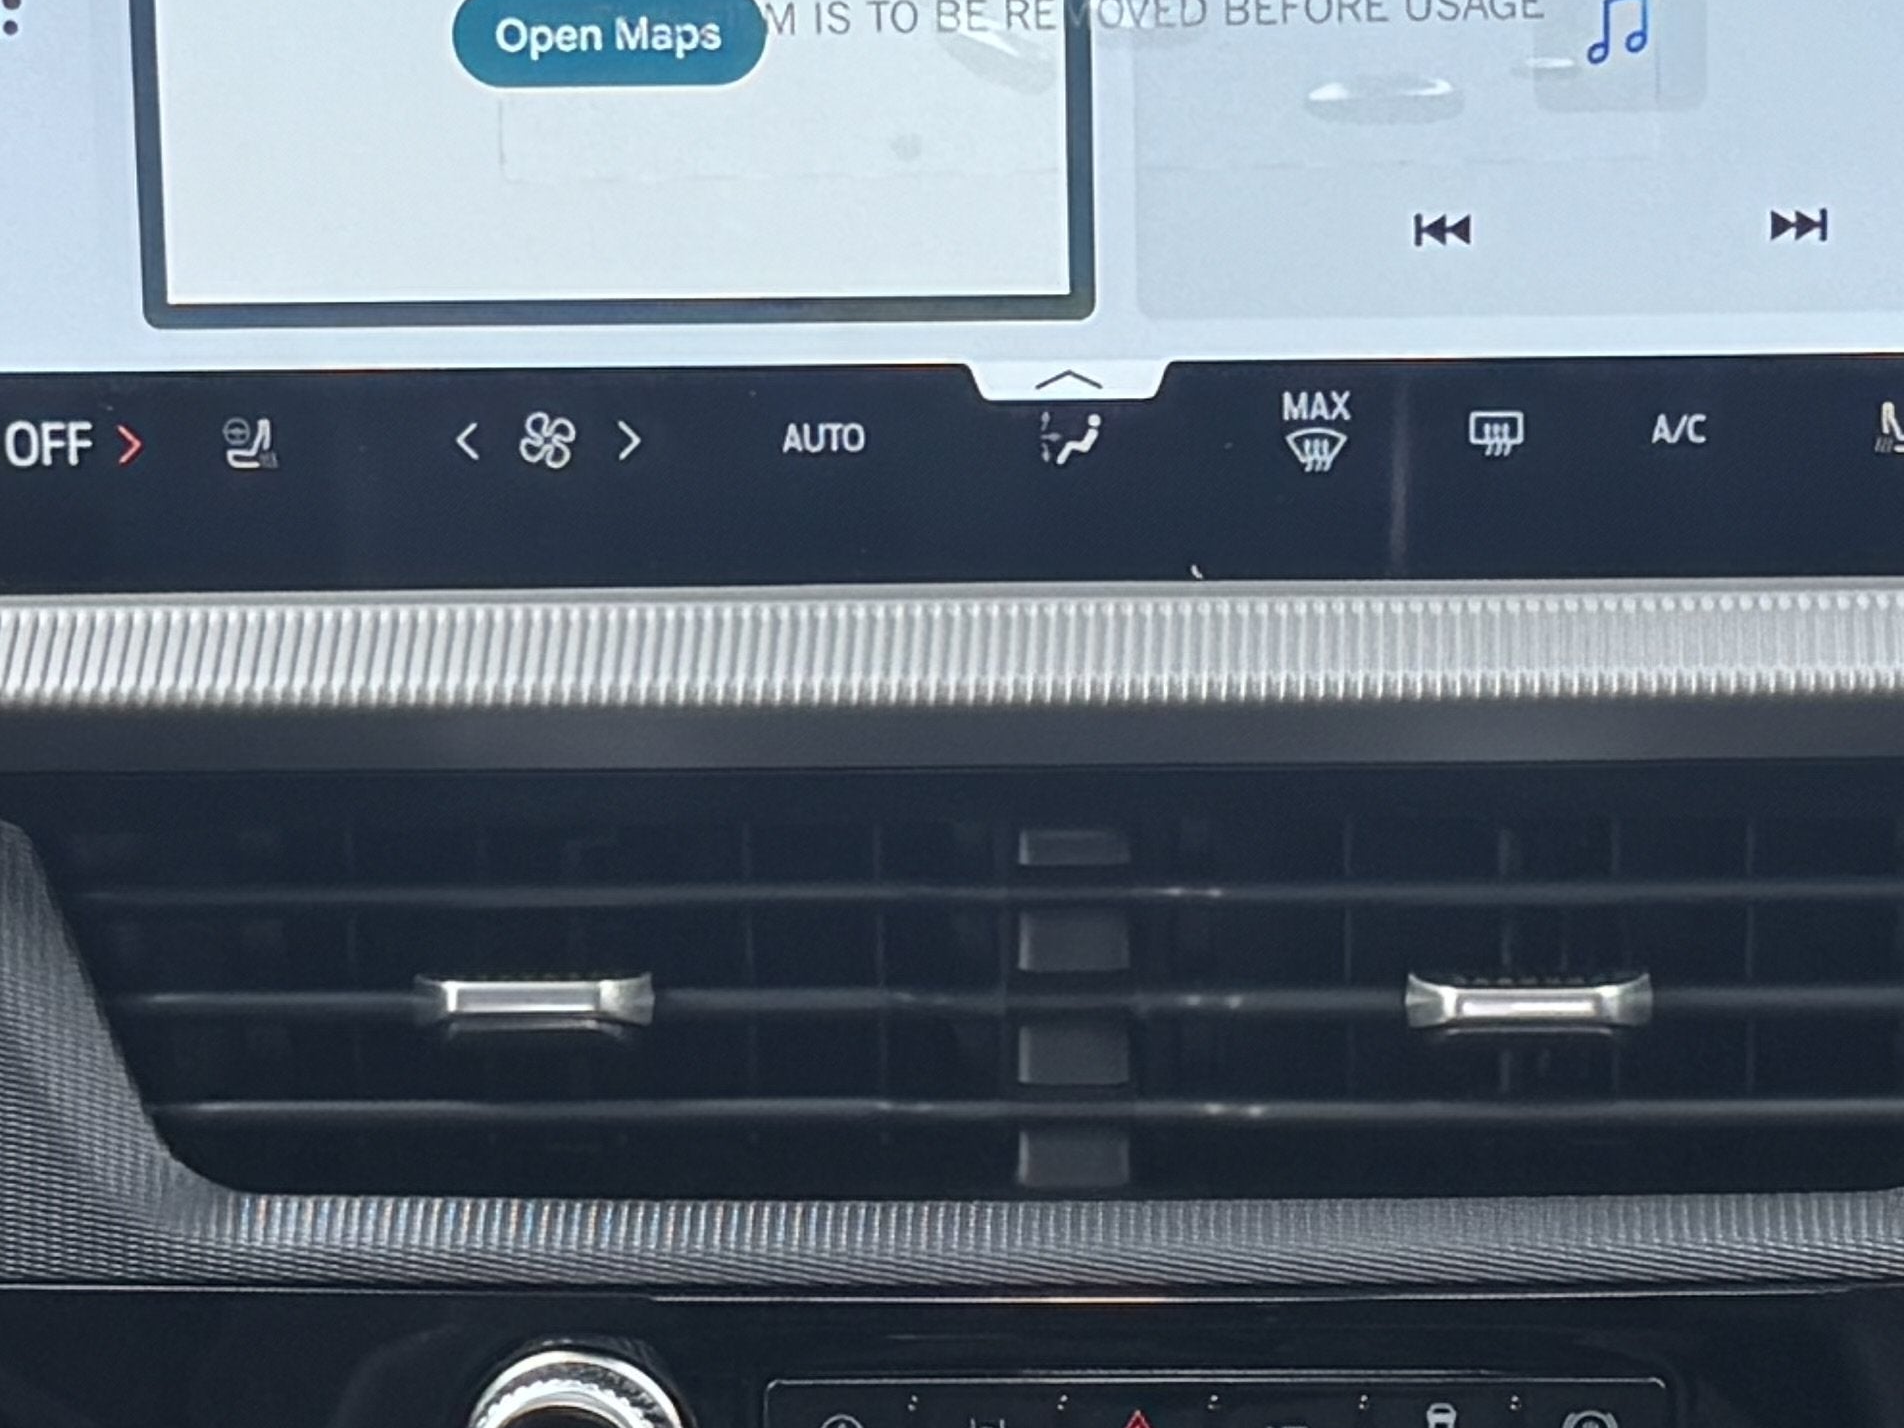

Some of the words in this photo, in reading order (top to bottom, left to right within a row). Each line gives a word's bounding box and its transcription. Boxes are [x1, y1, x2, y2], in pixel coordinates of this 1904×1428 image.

[815, 0, 851, 36] IS
[496, 17, 604, 61] Open
[614, 15, 723, 60] Maps
[1282, 390, 1352, 421] MAX
[4, 419, 94, 467] OFF
[782, 422, 866, 453] AUTO
[1651, 413, 1707, 444] A/C
